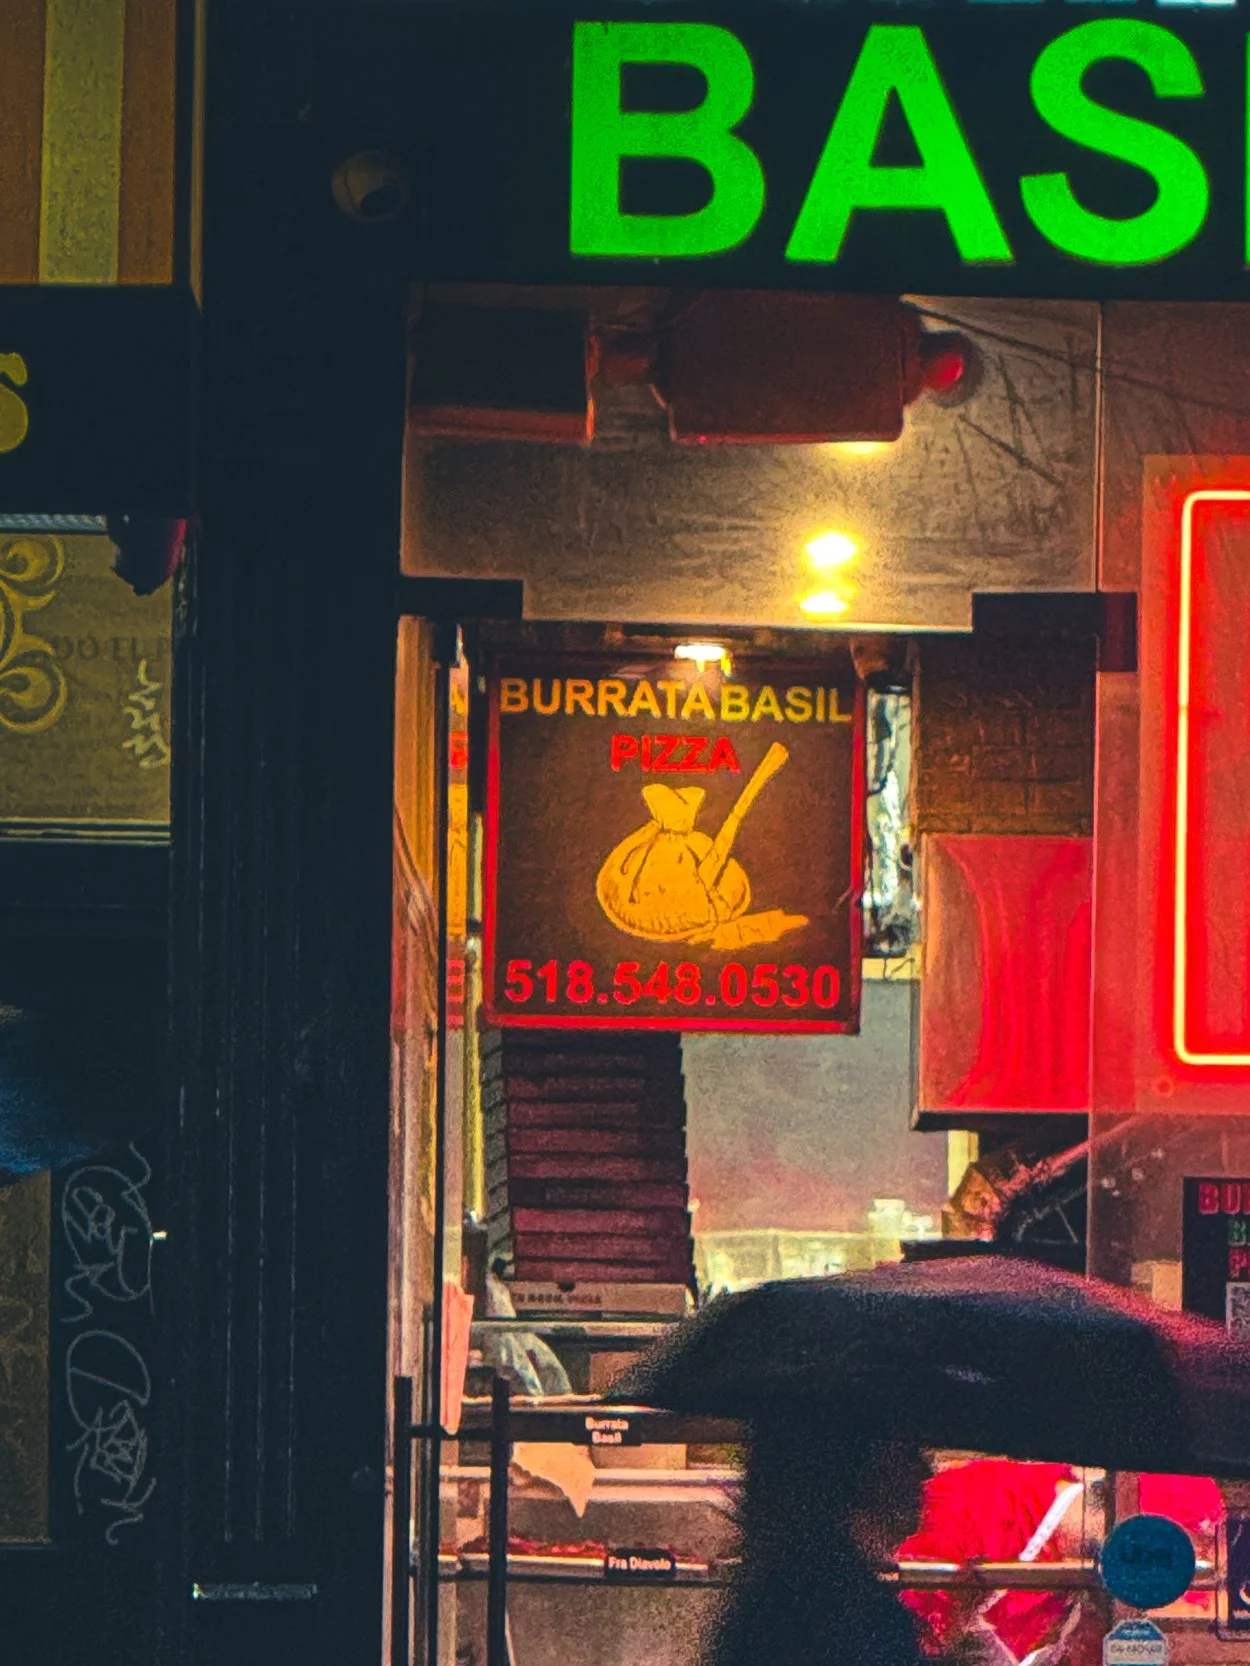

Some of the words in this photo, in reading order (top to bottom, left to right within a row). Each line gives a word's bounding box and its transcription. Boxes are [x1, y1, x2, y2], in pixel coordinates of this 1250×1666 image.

[500, 678, 716, 720] BURRATA
[720, 683, 853, 724] BASIL
[610, 733, 741, 774] PIZZA
[503, 958, 841, 1009] 518.548.0530
